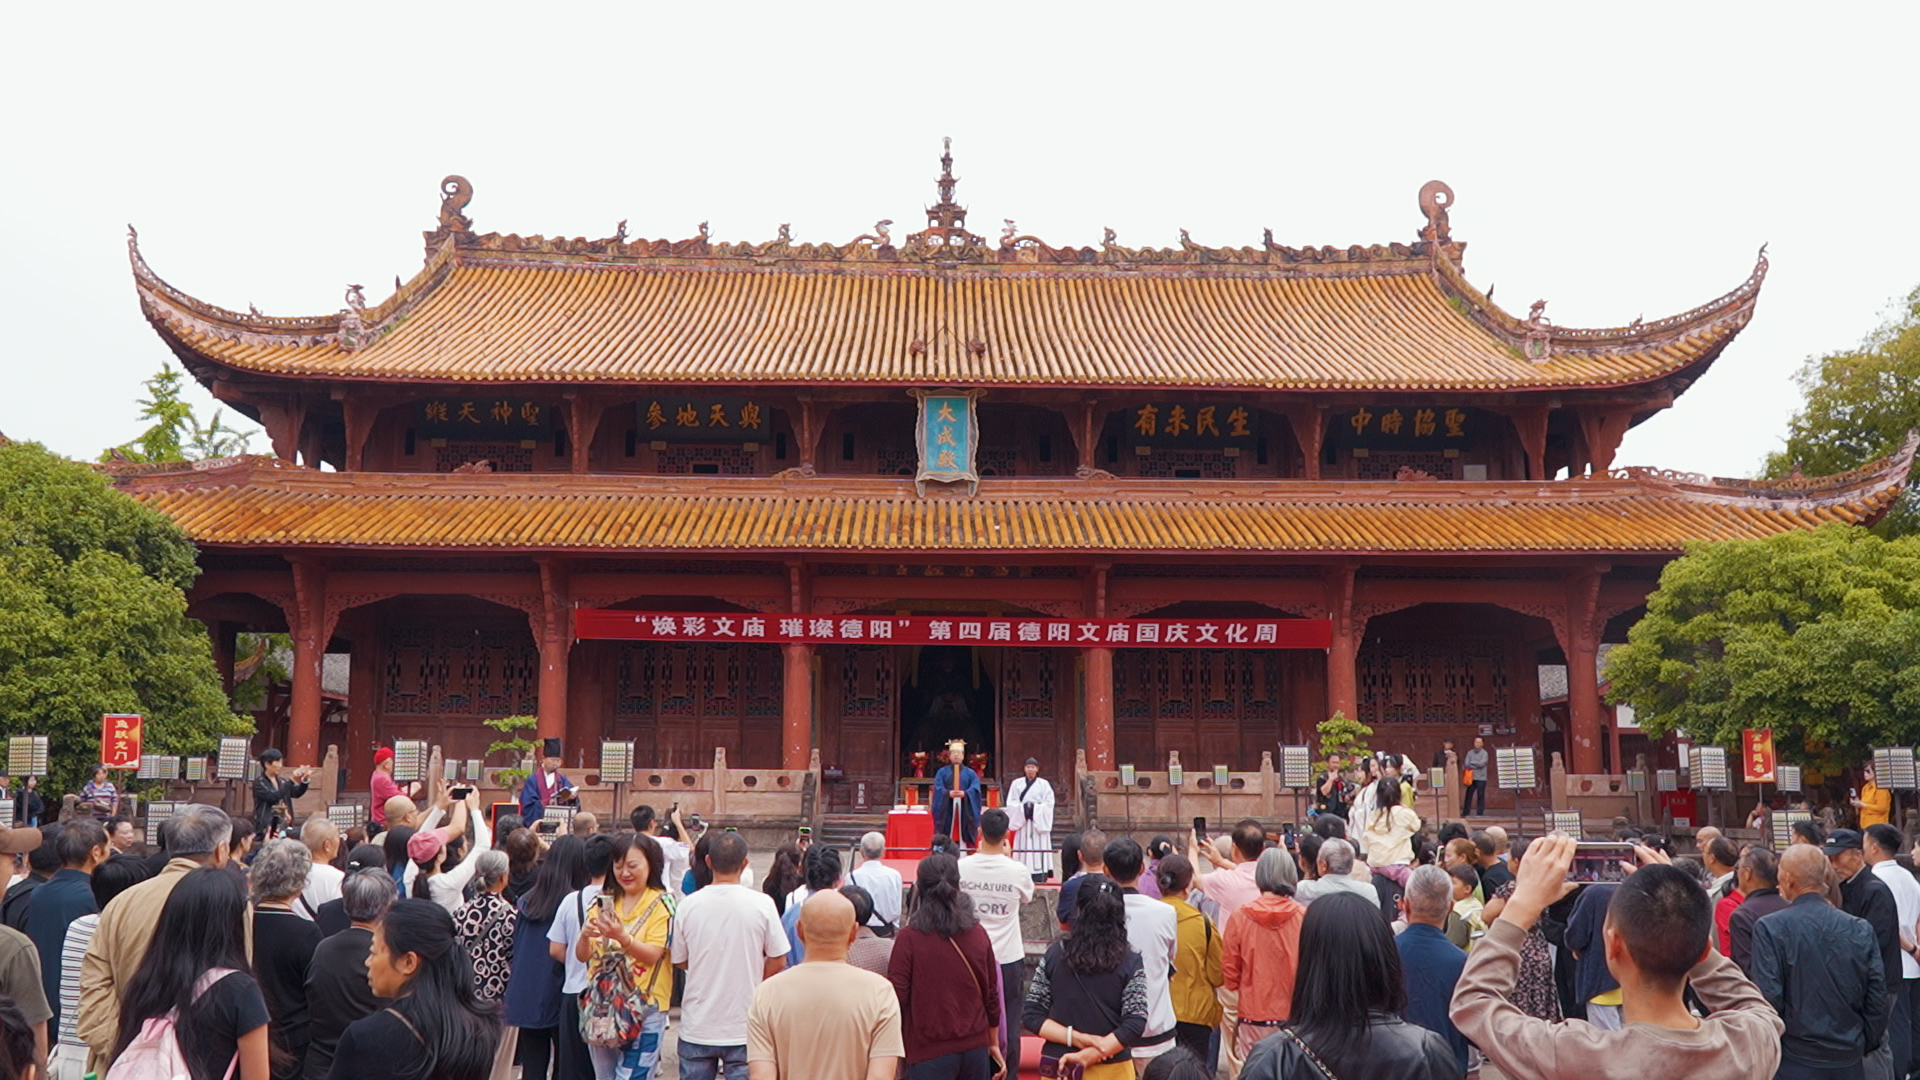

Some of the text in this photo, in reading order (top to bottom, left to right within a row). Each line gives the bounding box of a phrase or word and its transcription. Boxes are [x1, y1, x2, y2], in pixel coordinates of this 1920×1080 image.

[936, 400, 960, 471] 大成殿
[928, 619, 1278, 645] 第四届德阳文庙国庆文化周
